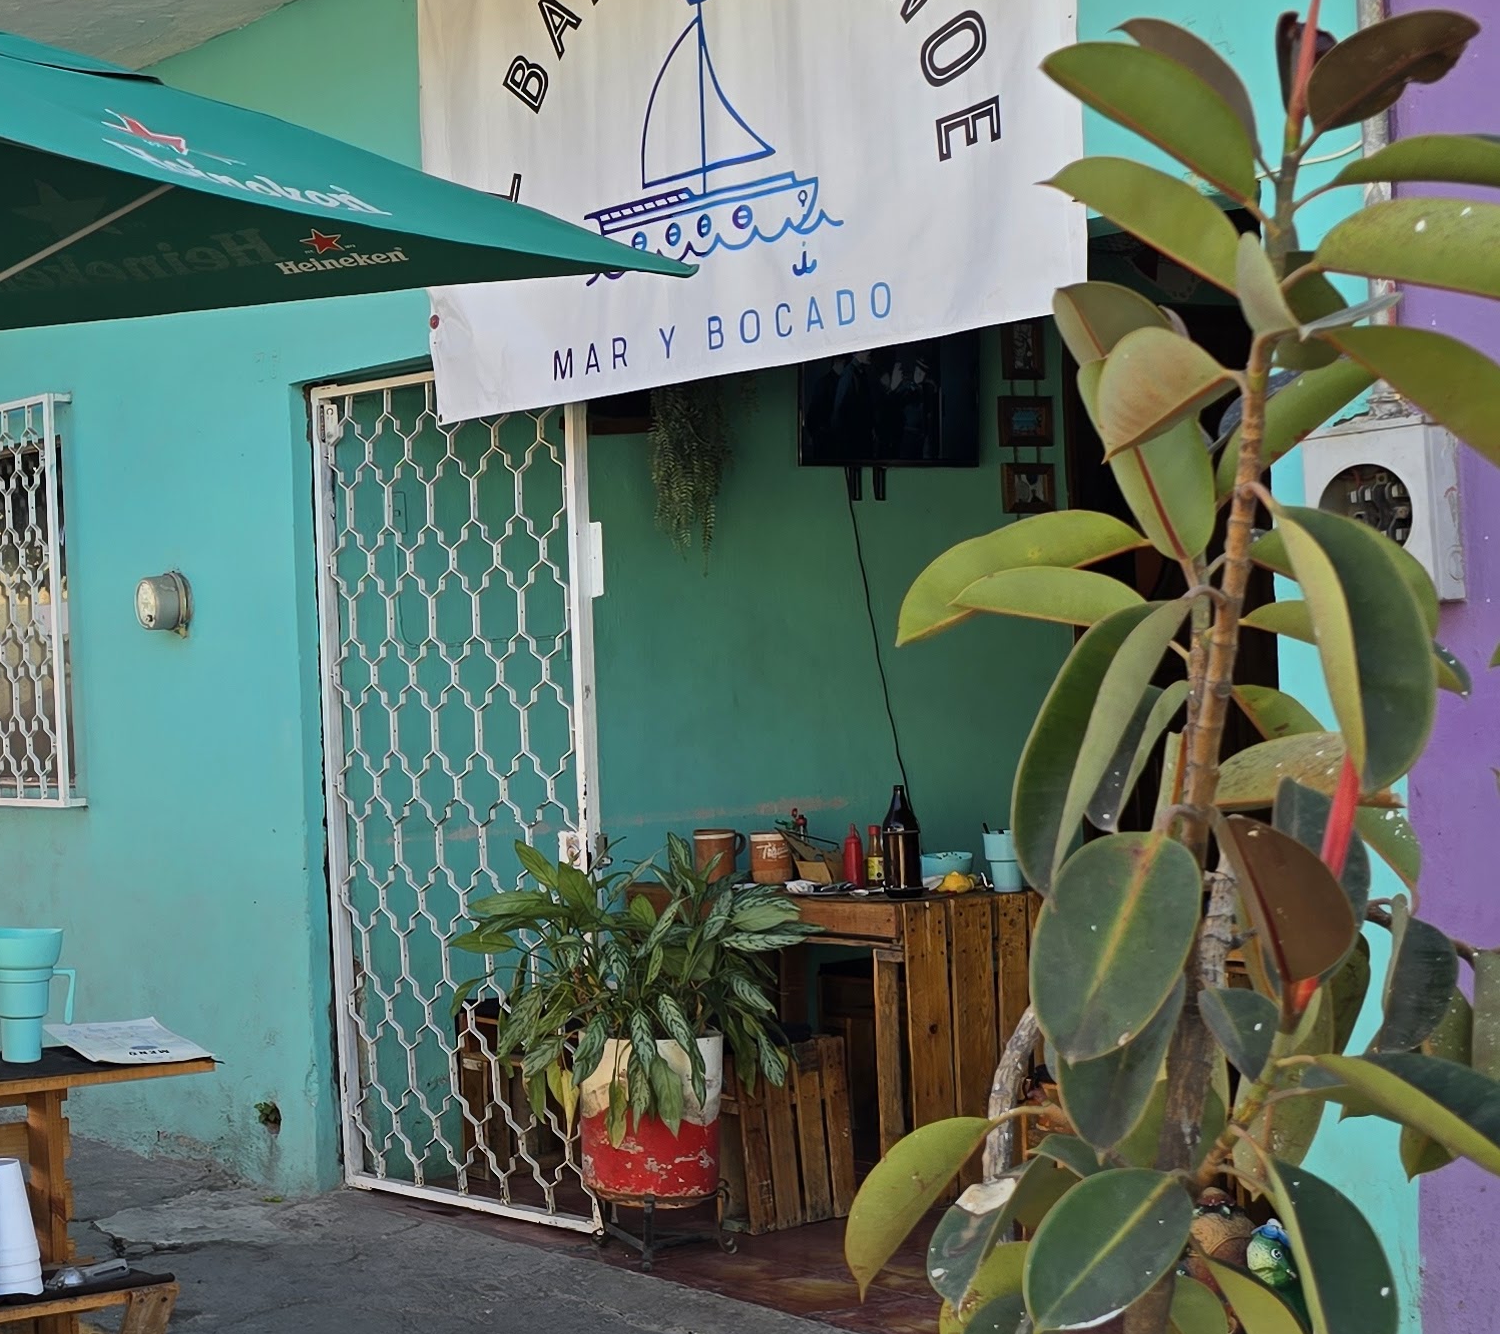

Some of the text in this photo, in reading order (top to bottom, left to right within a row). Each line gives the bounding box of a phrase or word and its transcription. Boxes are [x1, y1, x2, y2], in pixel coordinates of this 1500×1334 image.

[275, 250, 409, 275] Heineken
[553, 281, 893, 381] MAR Y BOCADO
